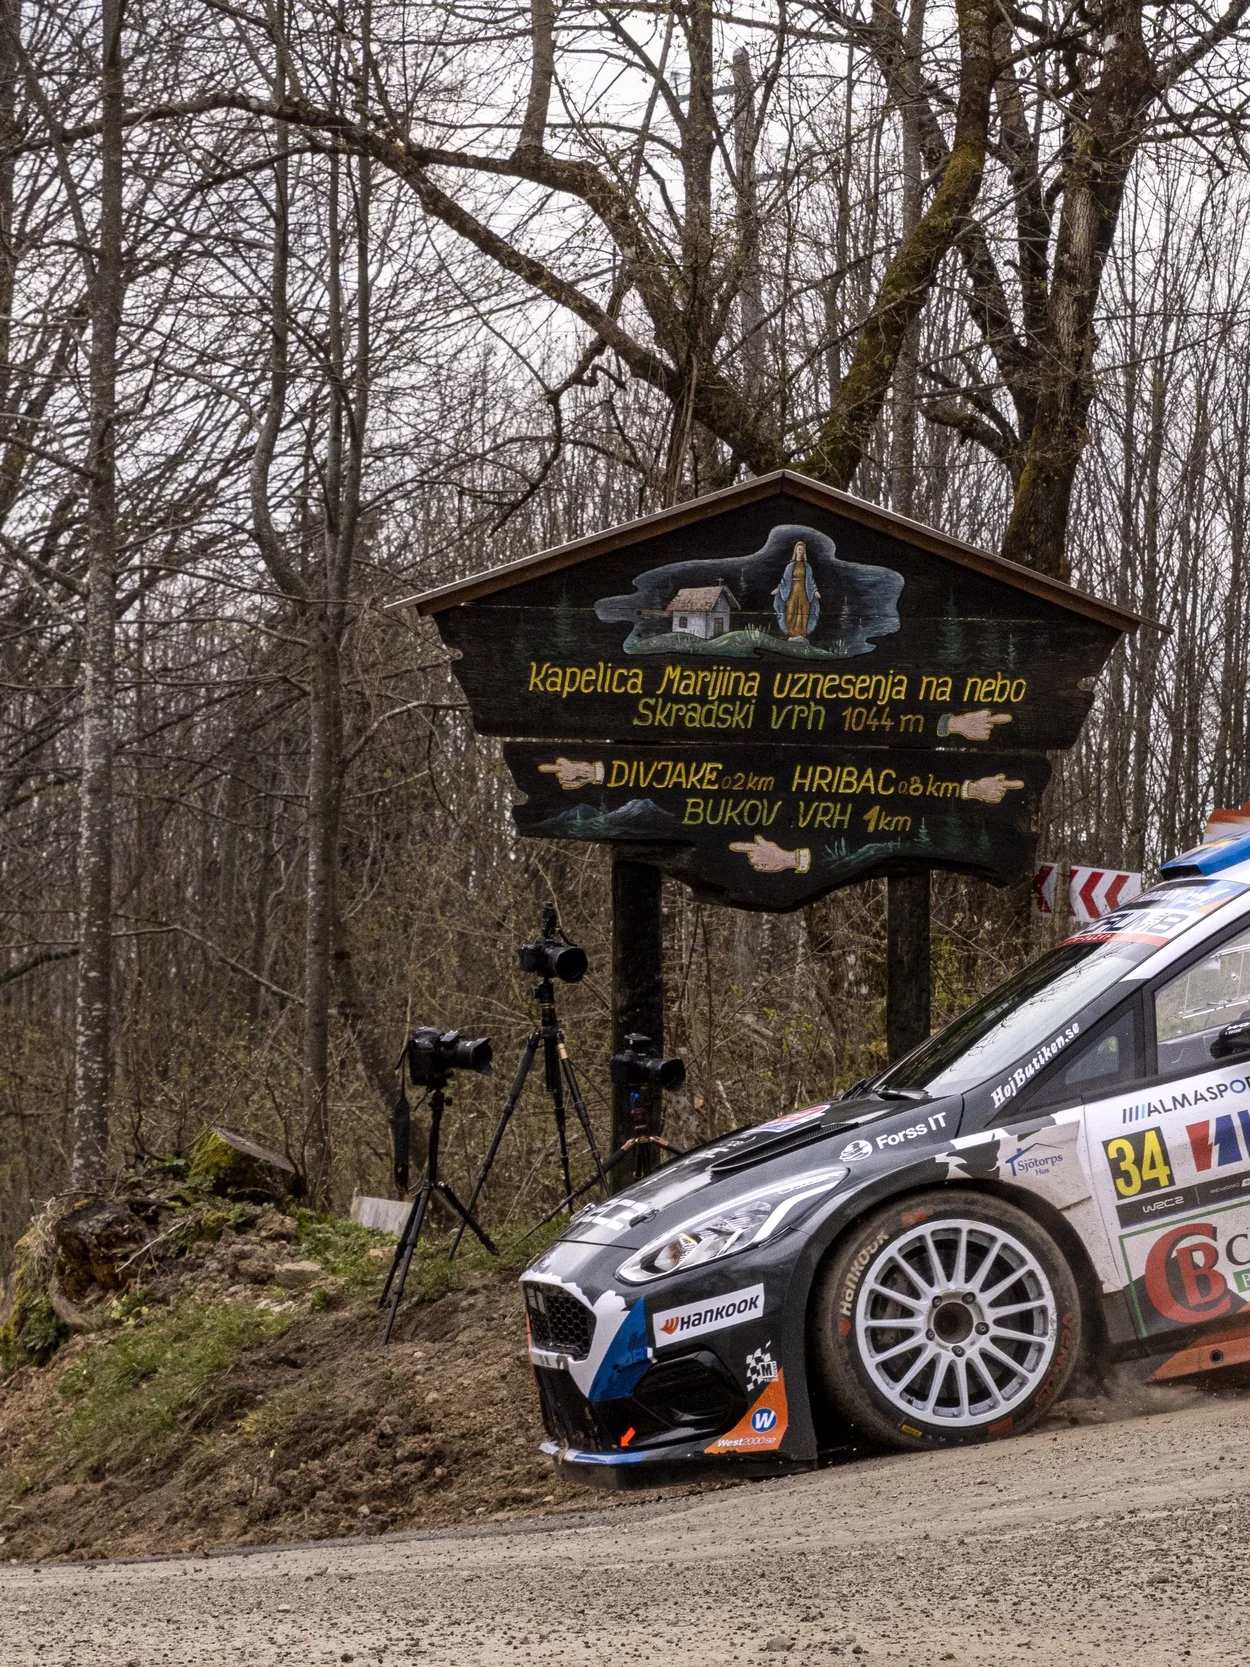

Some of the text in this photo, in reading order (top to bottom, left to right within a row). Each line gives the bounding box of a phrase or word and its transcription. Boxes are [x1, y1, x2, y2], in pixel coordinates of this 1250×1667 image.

[528, 661, 1027, 705] Kapelica Marijina uznesenja na nebo
[632, 697, 924, 733] Skradski vrh 1044 m
[606, 759, 724, 790] DIVJAKE
[791, 764, 897, 796] HRIBAC
[681, 797, 783, 826] BUKOV
[798, 801, 852, 829] VRH
[990, 1021, 1081, 1109] HojButiken.se
[875, 1111, 948, 1151] Forss IT
[1016, 1152, 1064, 1176] Sjötorps
[1034, 1167, 1050, 1177] Hus
[1106, 1129, 1171, 1198] 34
[1141, 1195, 1185, 1214] WRC2
[755, 1410, 776, 1429] W
